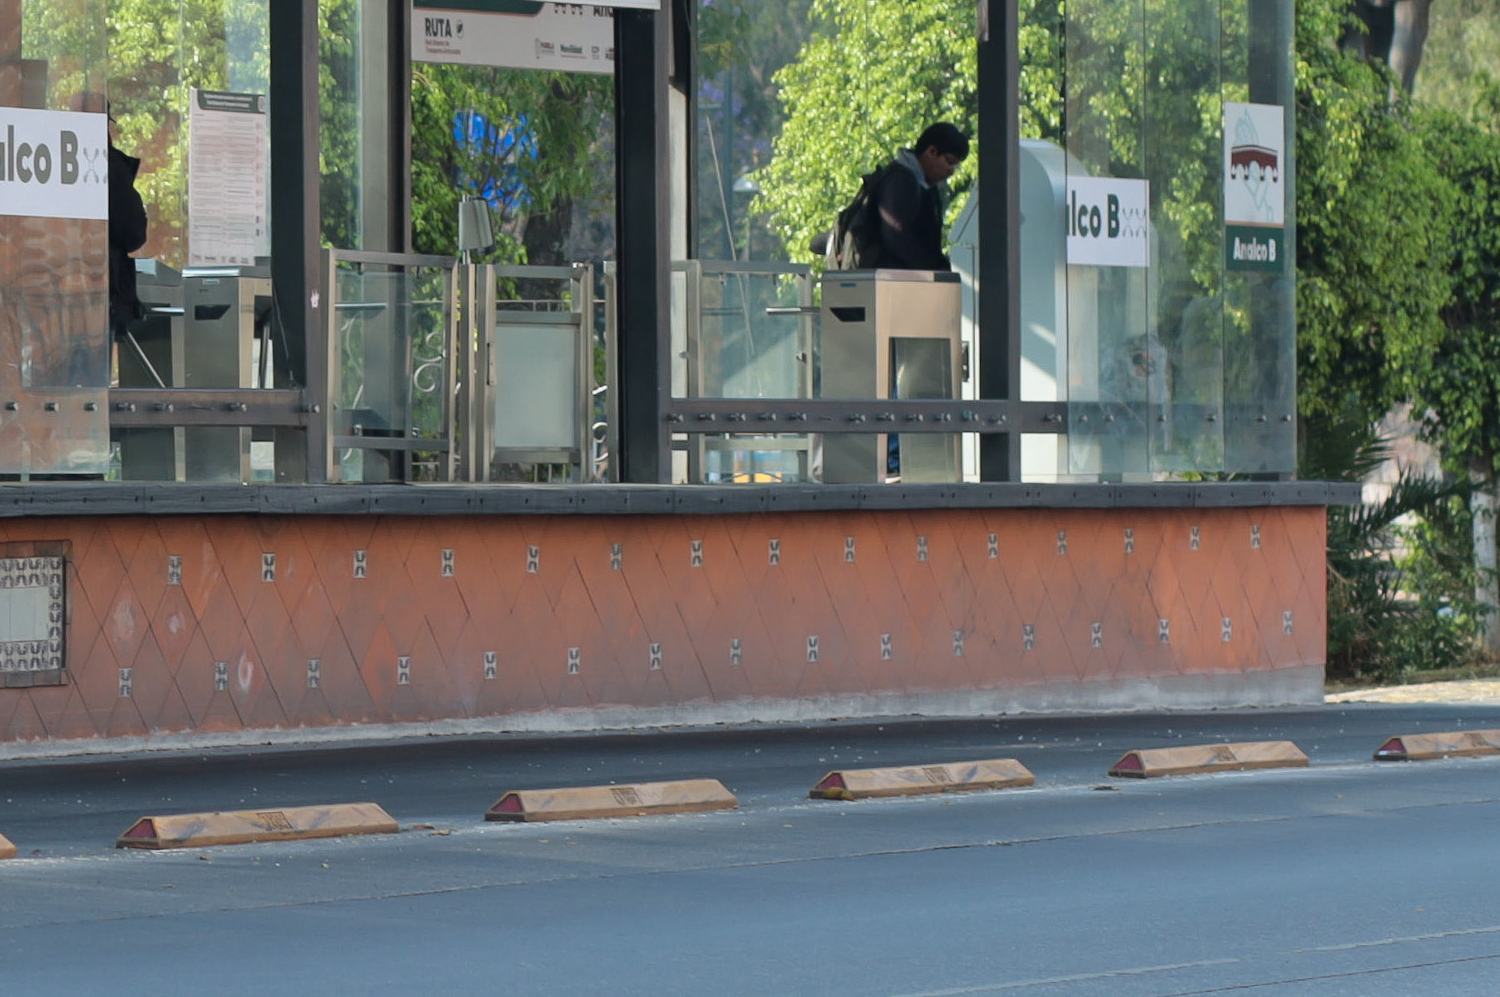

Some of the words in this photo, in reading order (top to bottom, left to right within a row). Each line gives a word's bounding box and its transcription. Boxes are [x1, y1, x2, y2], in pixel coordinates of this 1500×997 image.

[425, 17, 452, 38] RUTA
[60, 130, 80, 185] B
[1107, 193, 1120, 238] B
[1233, 236, 1268, 261] Analco
[1269, 238, 1276, 262] B
